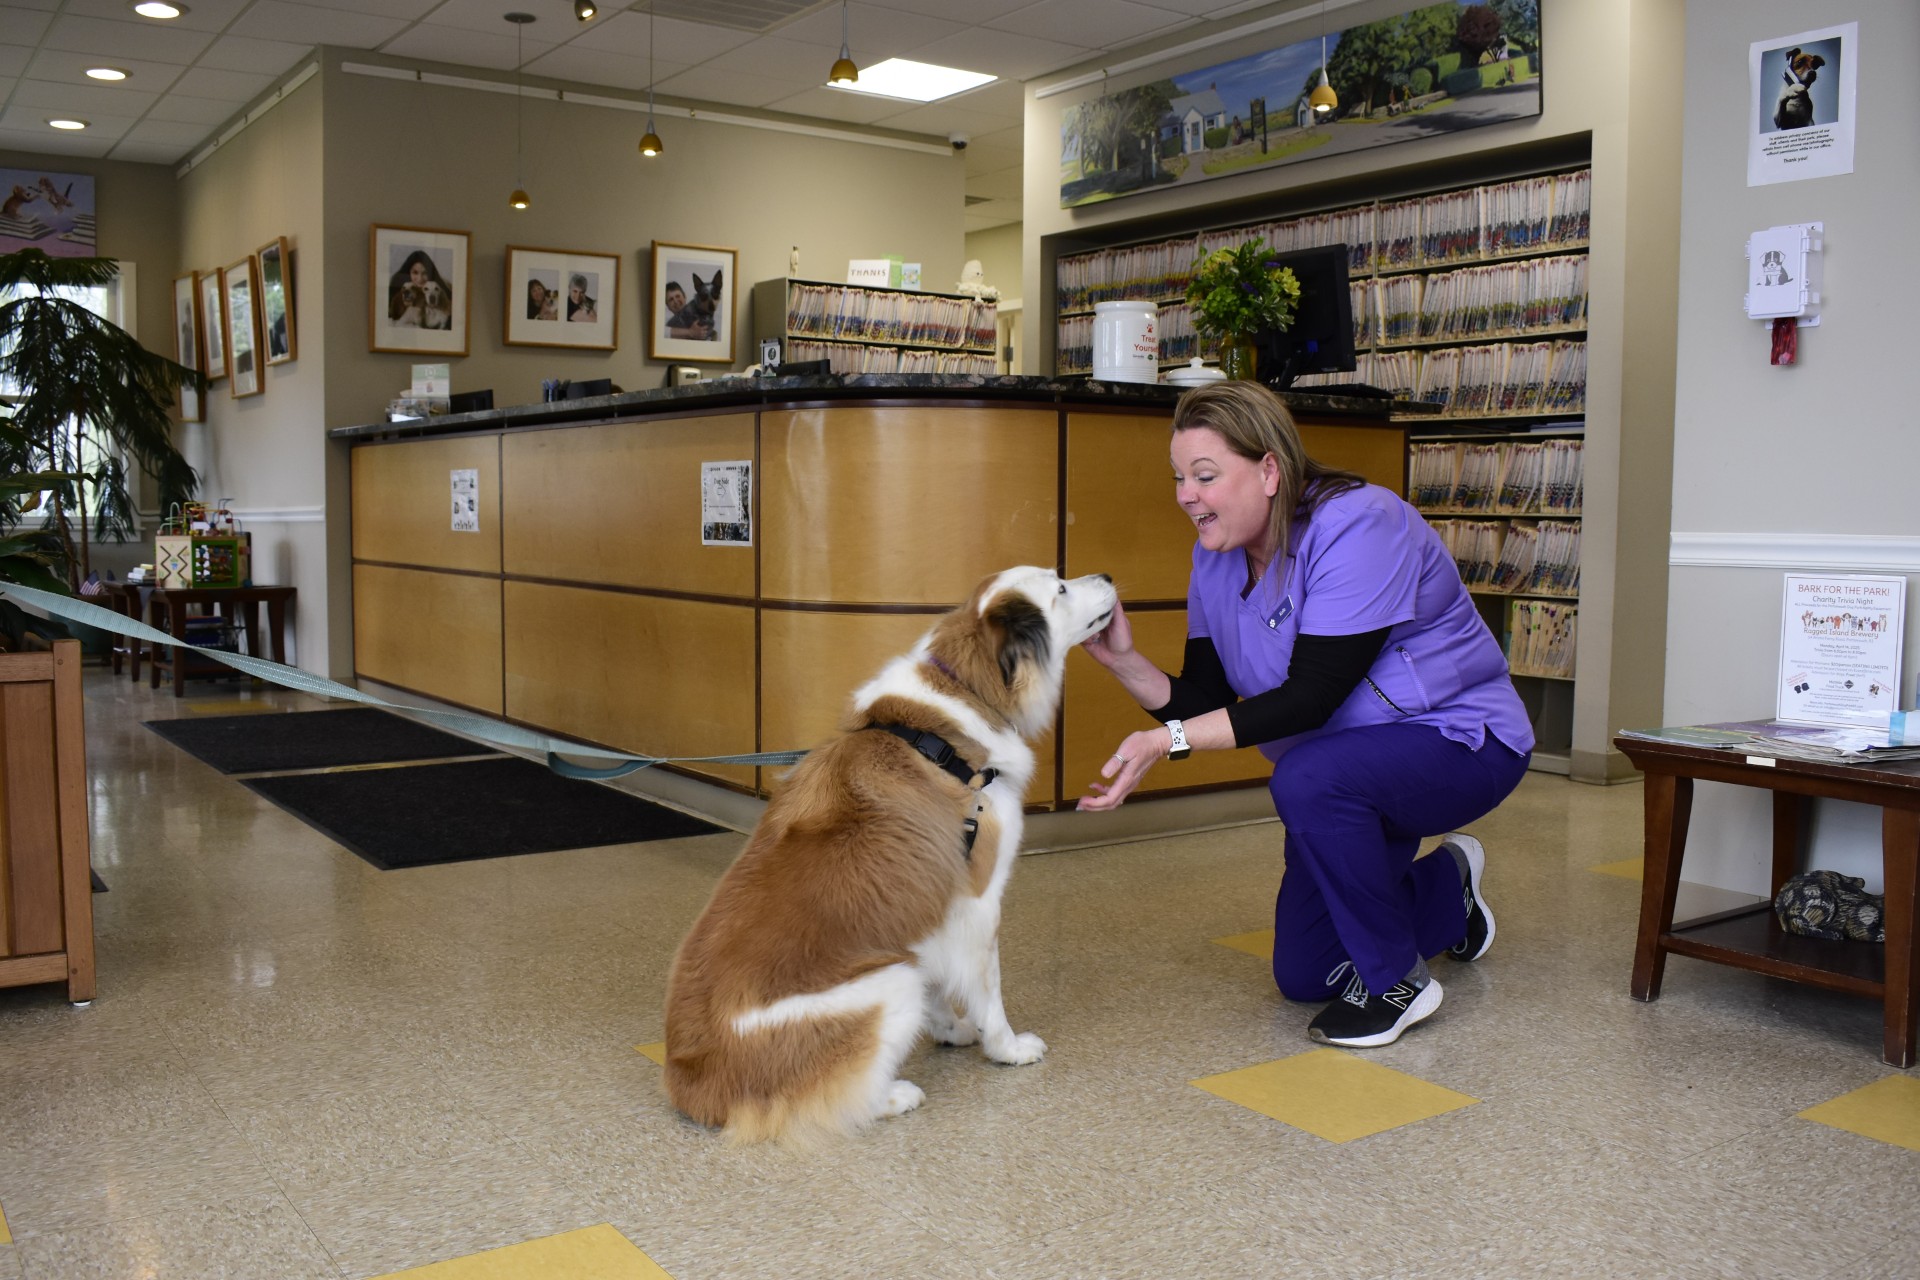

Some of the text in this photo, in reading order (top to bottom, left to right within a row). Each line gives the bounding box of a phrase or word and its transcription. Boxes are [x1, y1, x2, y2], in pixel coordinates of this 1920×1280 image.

[1798, 584, 1890, 596] BARK FOR THE PARK!
[1812, 595, 1836, 604] Charity
[1851, 630, 1878, 639] Brewery
[1382, 984, 1414, 1010] N
